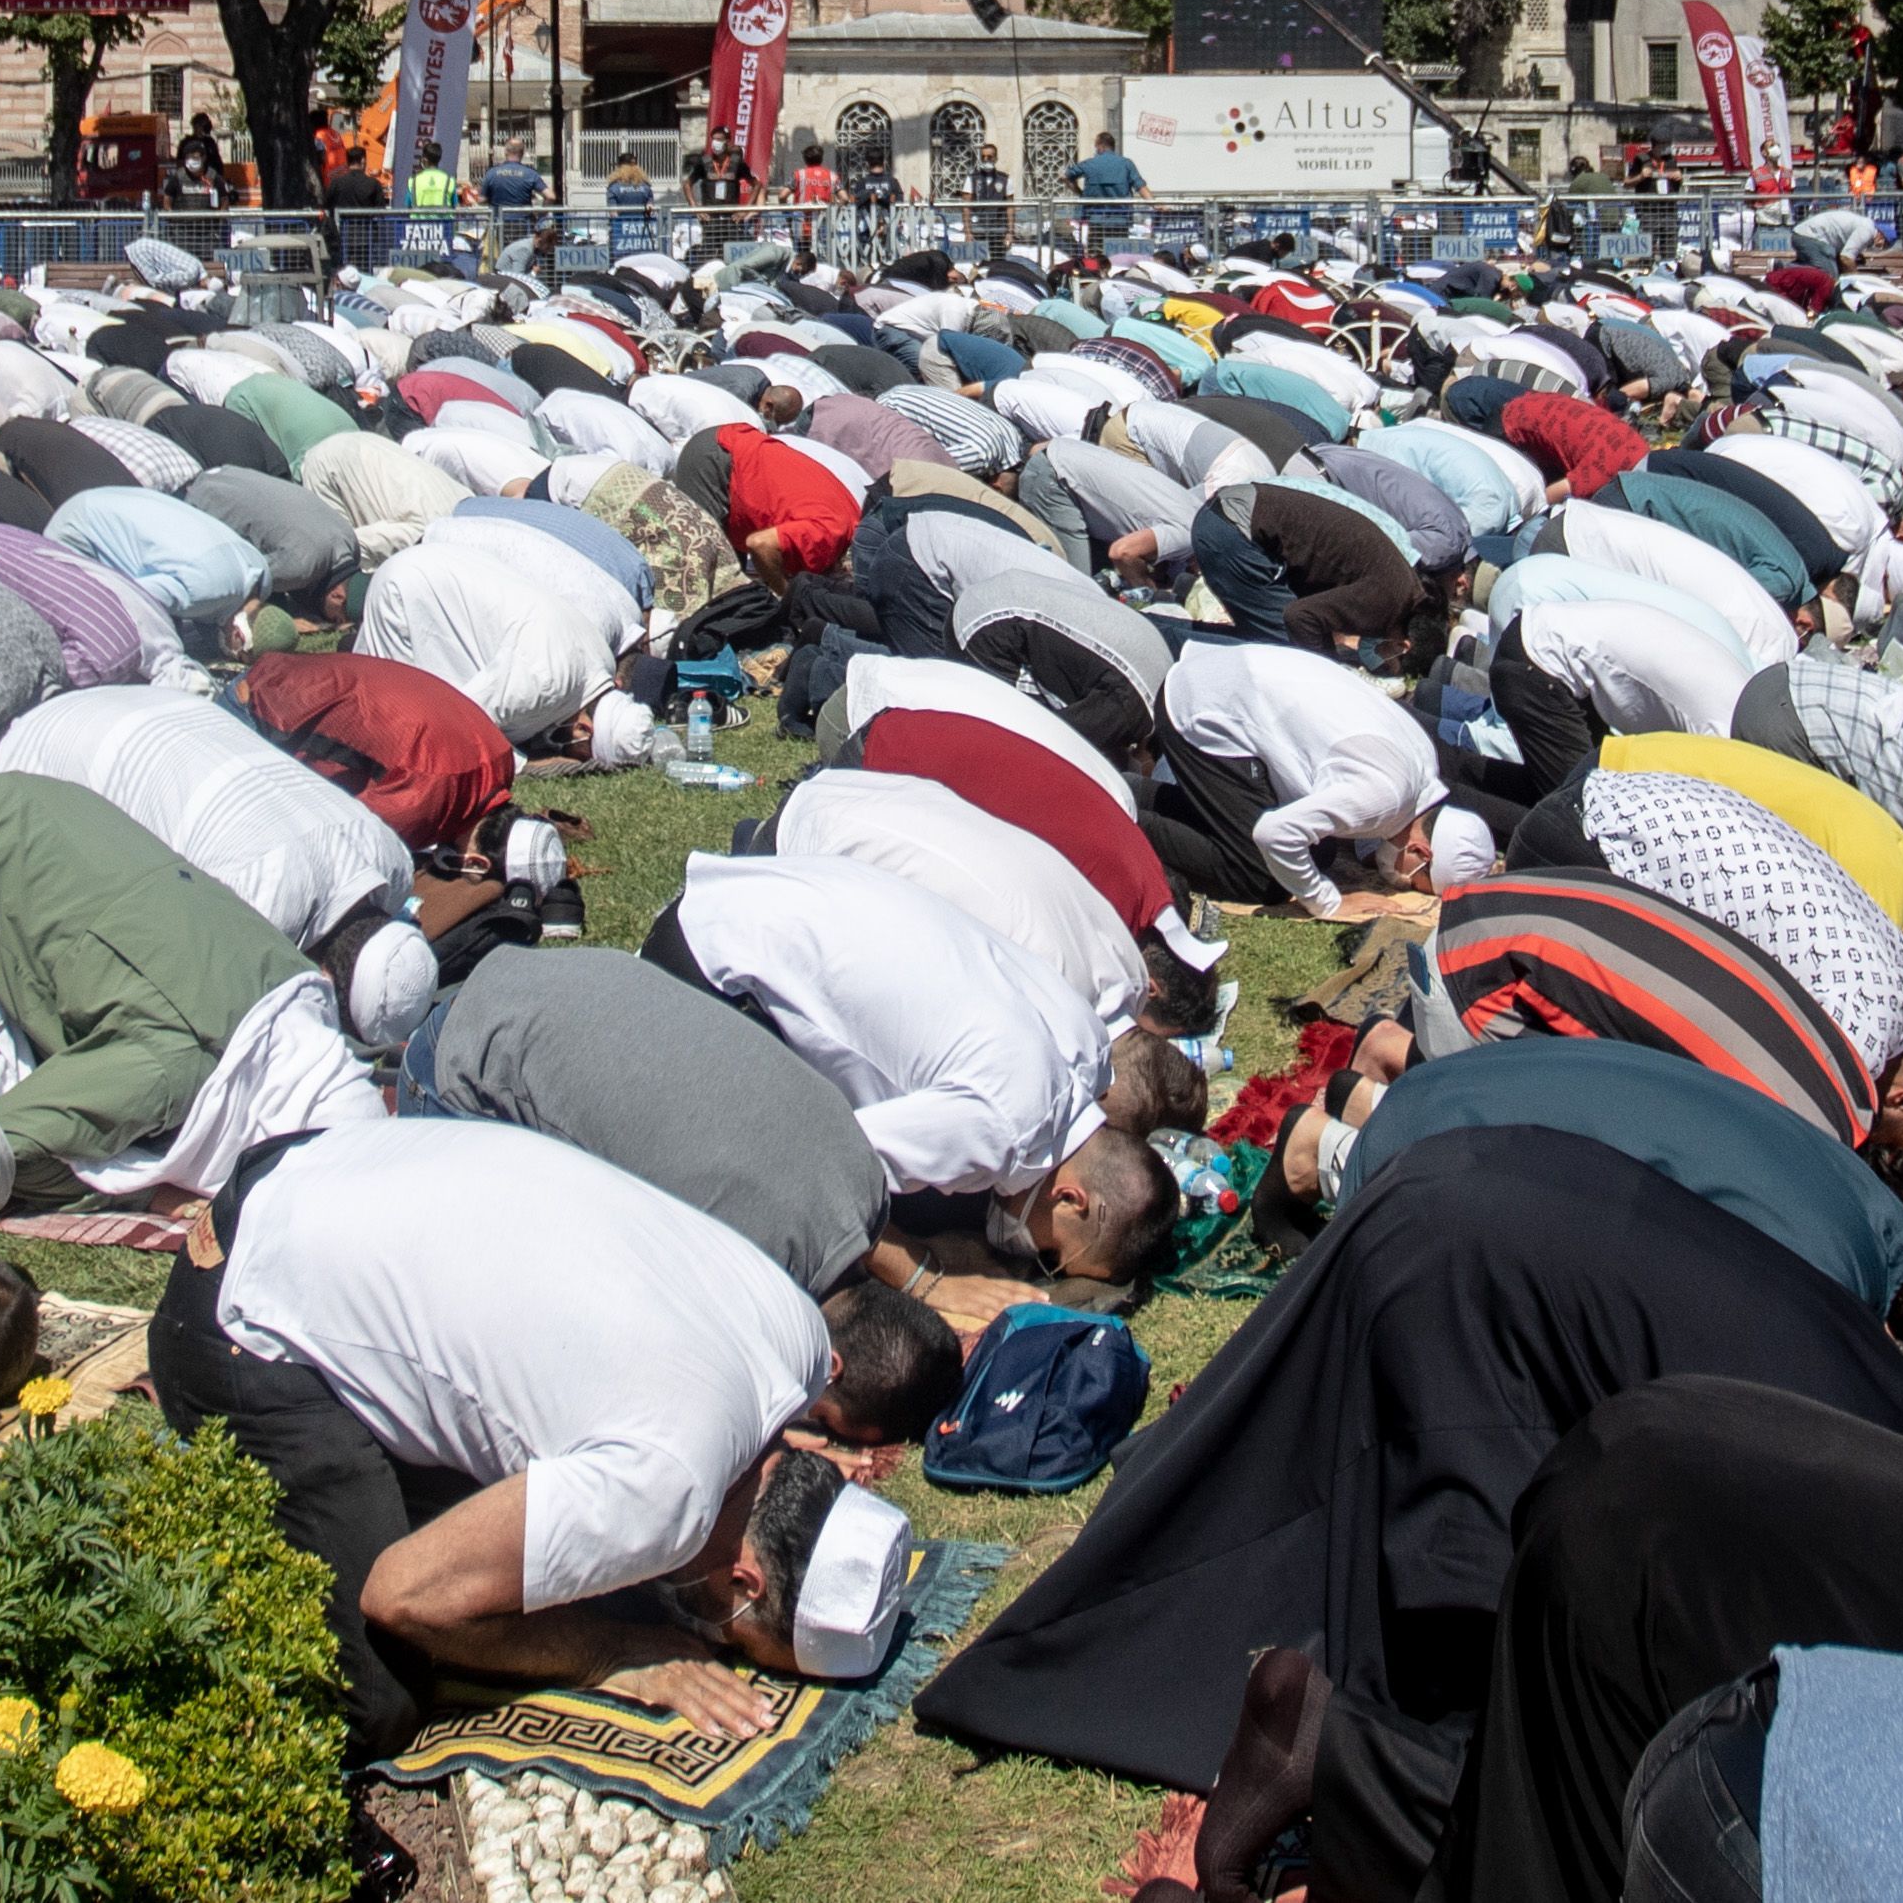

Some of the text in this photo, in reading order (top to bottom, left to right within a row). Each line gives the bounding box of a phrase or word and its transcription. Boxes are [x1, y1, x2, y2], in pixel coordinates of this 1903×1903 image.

[734, 51, 760, 151] ELEDİYESİ
[1275, 99, 1388, 130] Altus
[1297, 158, 1373, 170] MOBİL LED
[1265, 215, 1301, 227] FATİH
[1472, 212, 1508, 224] FATİH
[405, 224, 443, 240] FATİH
[1469, 228, 1514, 240] ZABITA
[1437, 244, 1479, 258] POLİS
[1607, 240, 1648, 256] POLİS
[558, 249, 608, 266] POLİS
